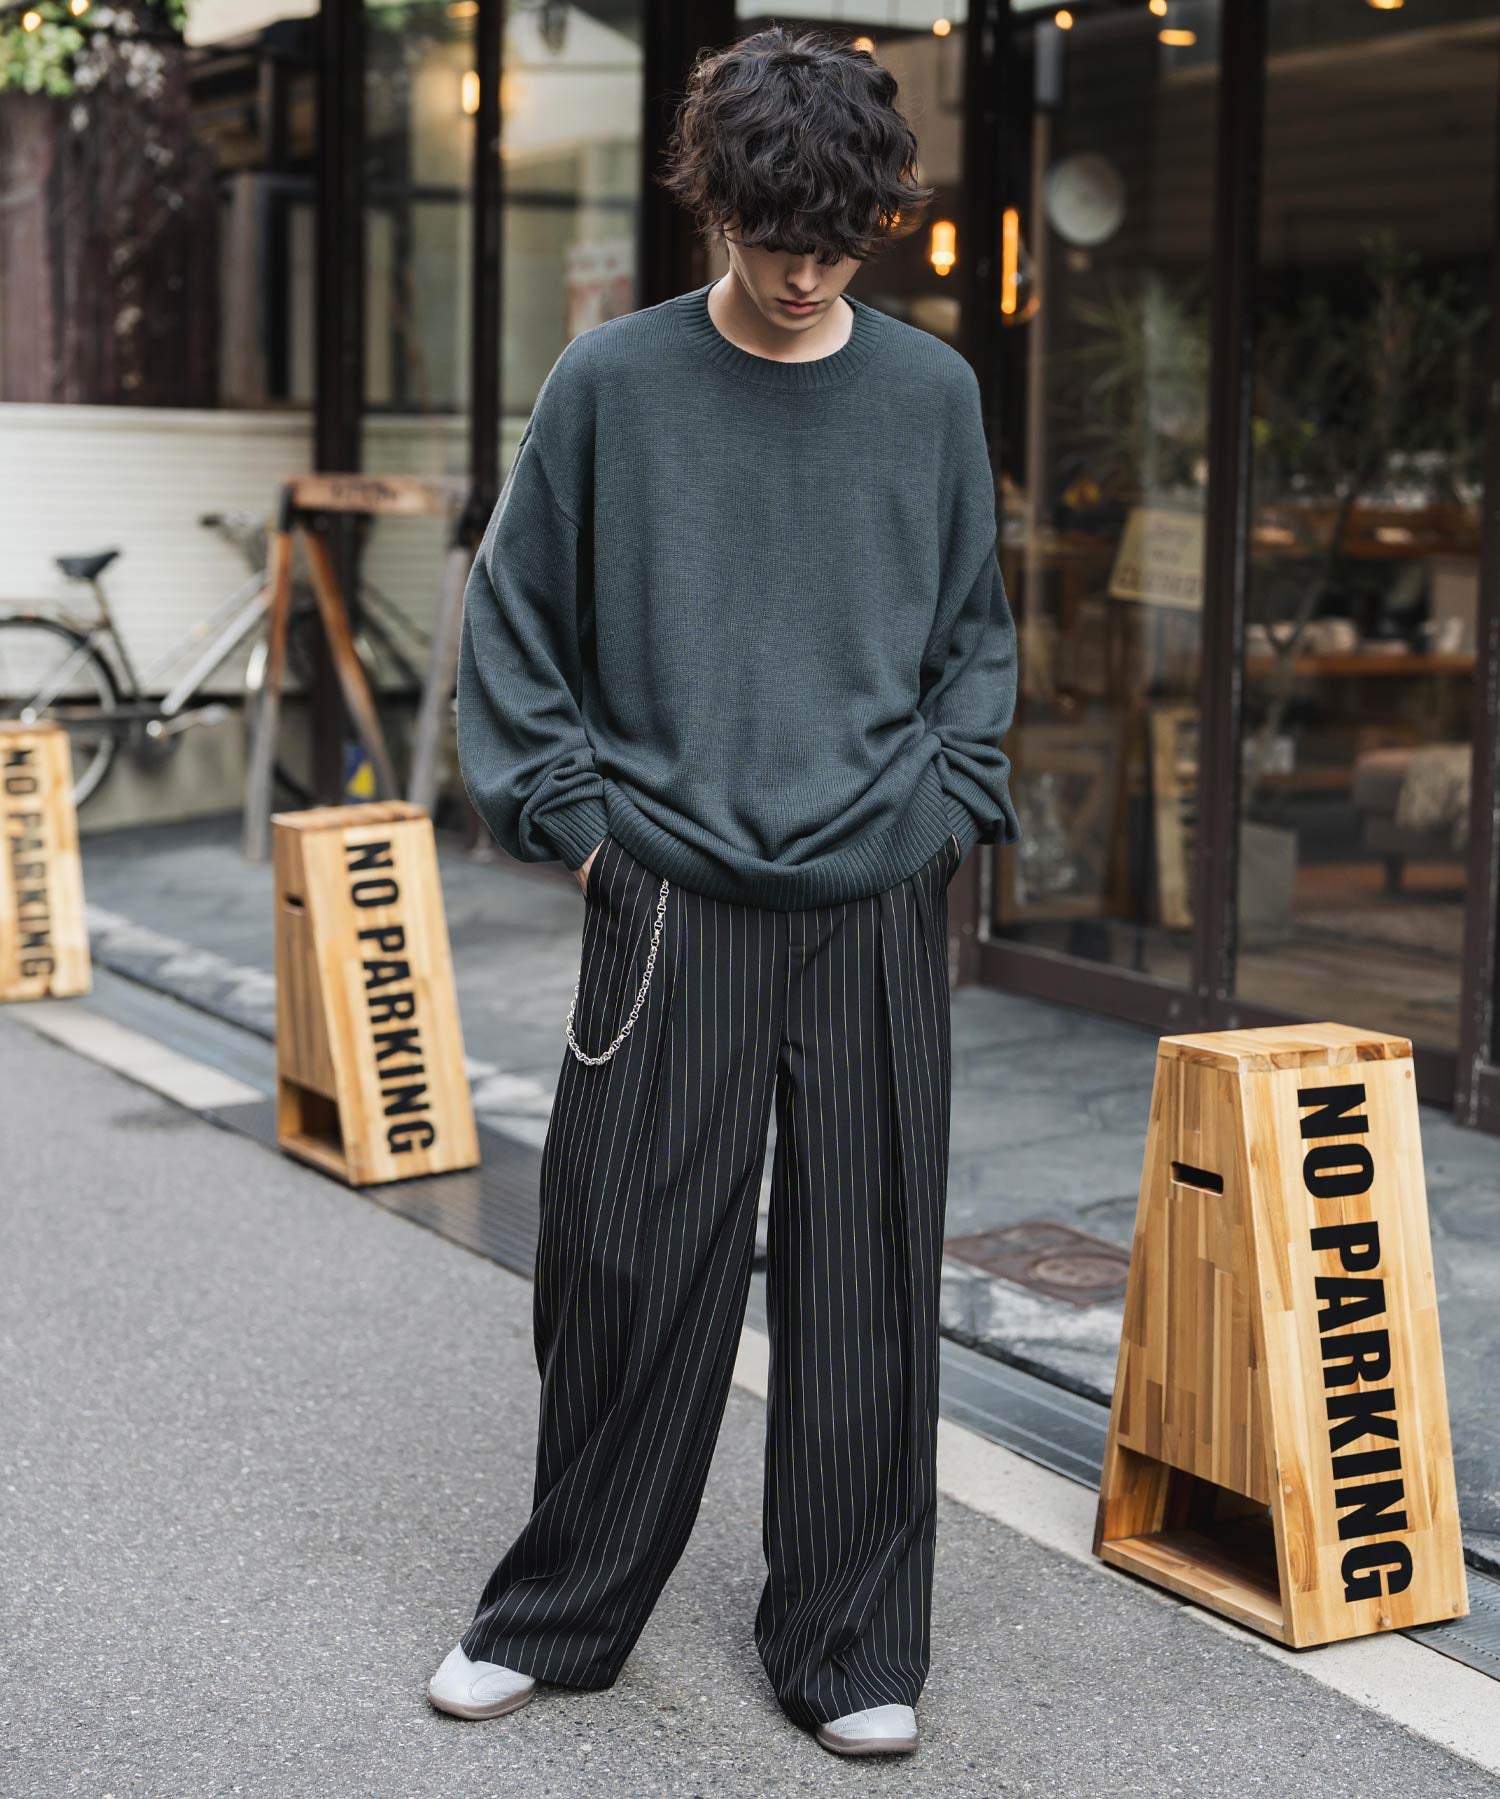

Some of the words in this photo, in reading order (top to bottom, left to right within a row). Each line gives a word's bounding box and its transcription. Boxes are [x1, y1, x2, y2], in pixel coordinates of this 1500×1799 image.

[3, 749, 37, 795] NO
[346, 841, 399, 909] NO
[357, 925, 435, 1155] PARKING
[1297, 1083, 1374, 1199] NO
[1310, 1221, 1413, 1603] PARKING
